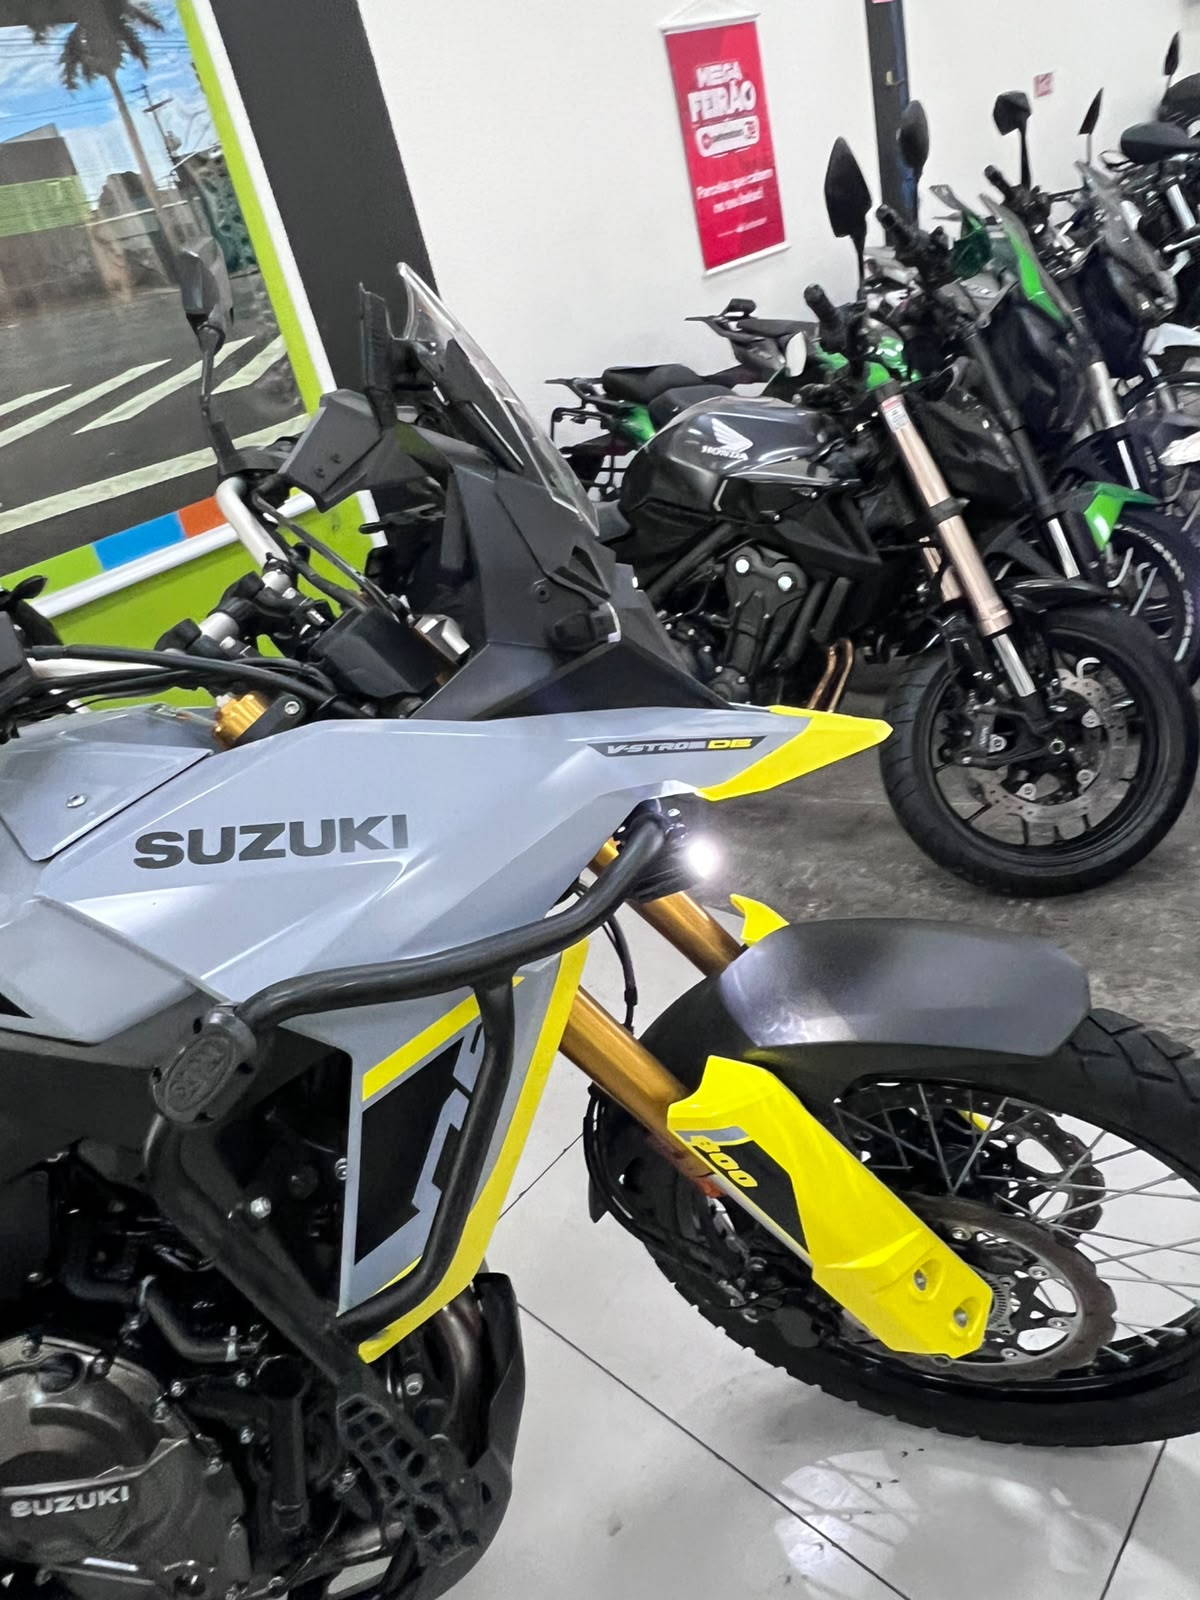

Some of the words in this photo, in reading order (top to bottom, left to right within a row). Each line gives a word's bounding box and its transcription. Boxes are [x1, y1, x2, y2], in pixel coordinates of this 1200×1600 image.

[701, 445, 749, 460] HONDA
[707, 738, 753, 749] DE
[133, 814, 408, 869] SUZUKI
[689, 1135, 758, 1187] 800
[10, 1486, 129, 1518] SUZUKI
